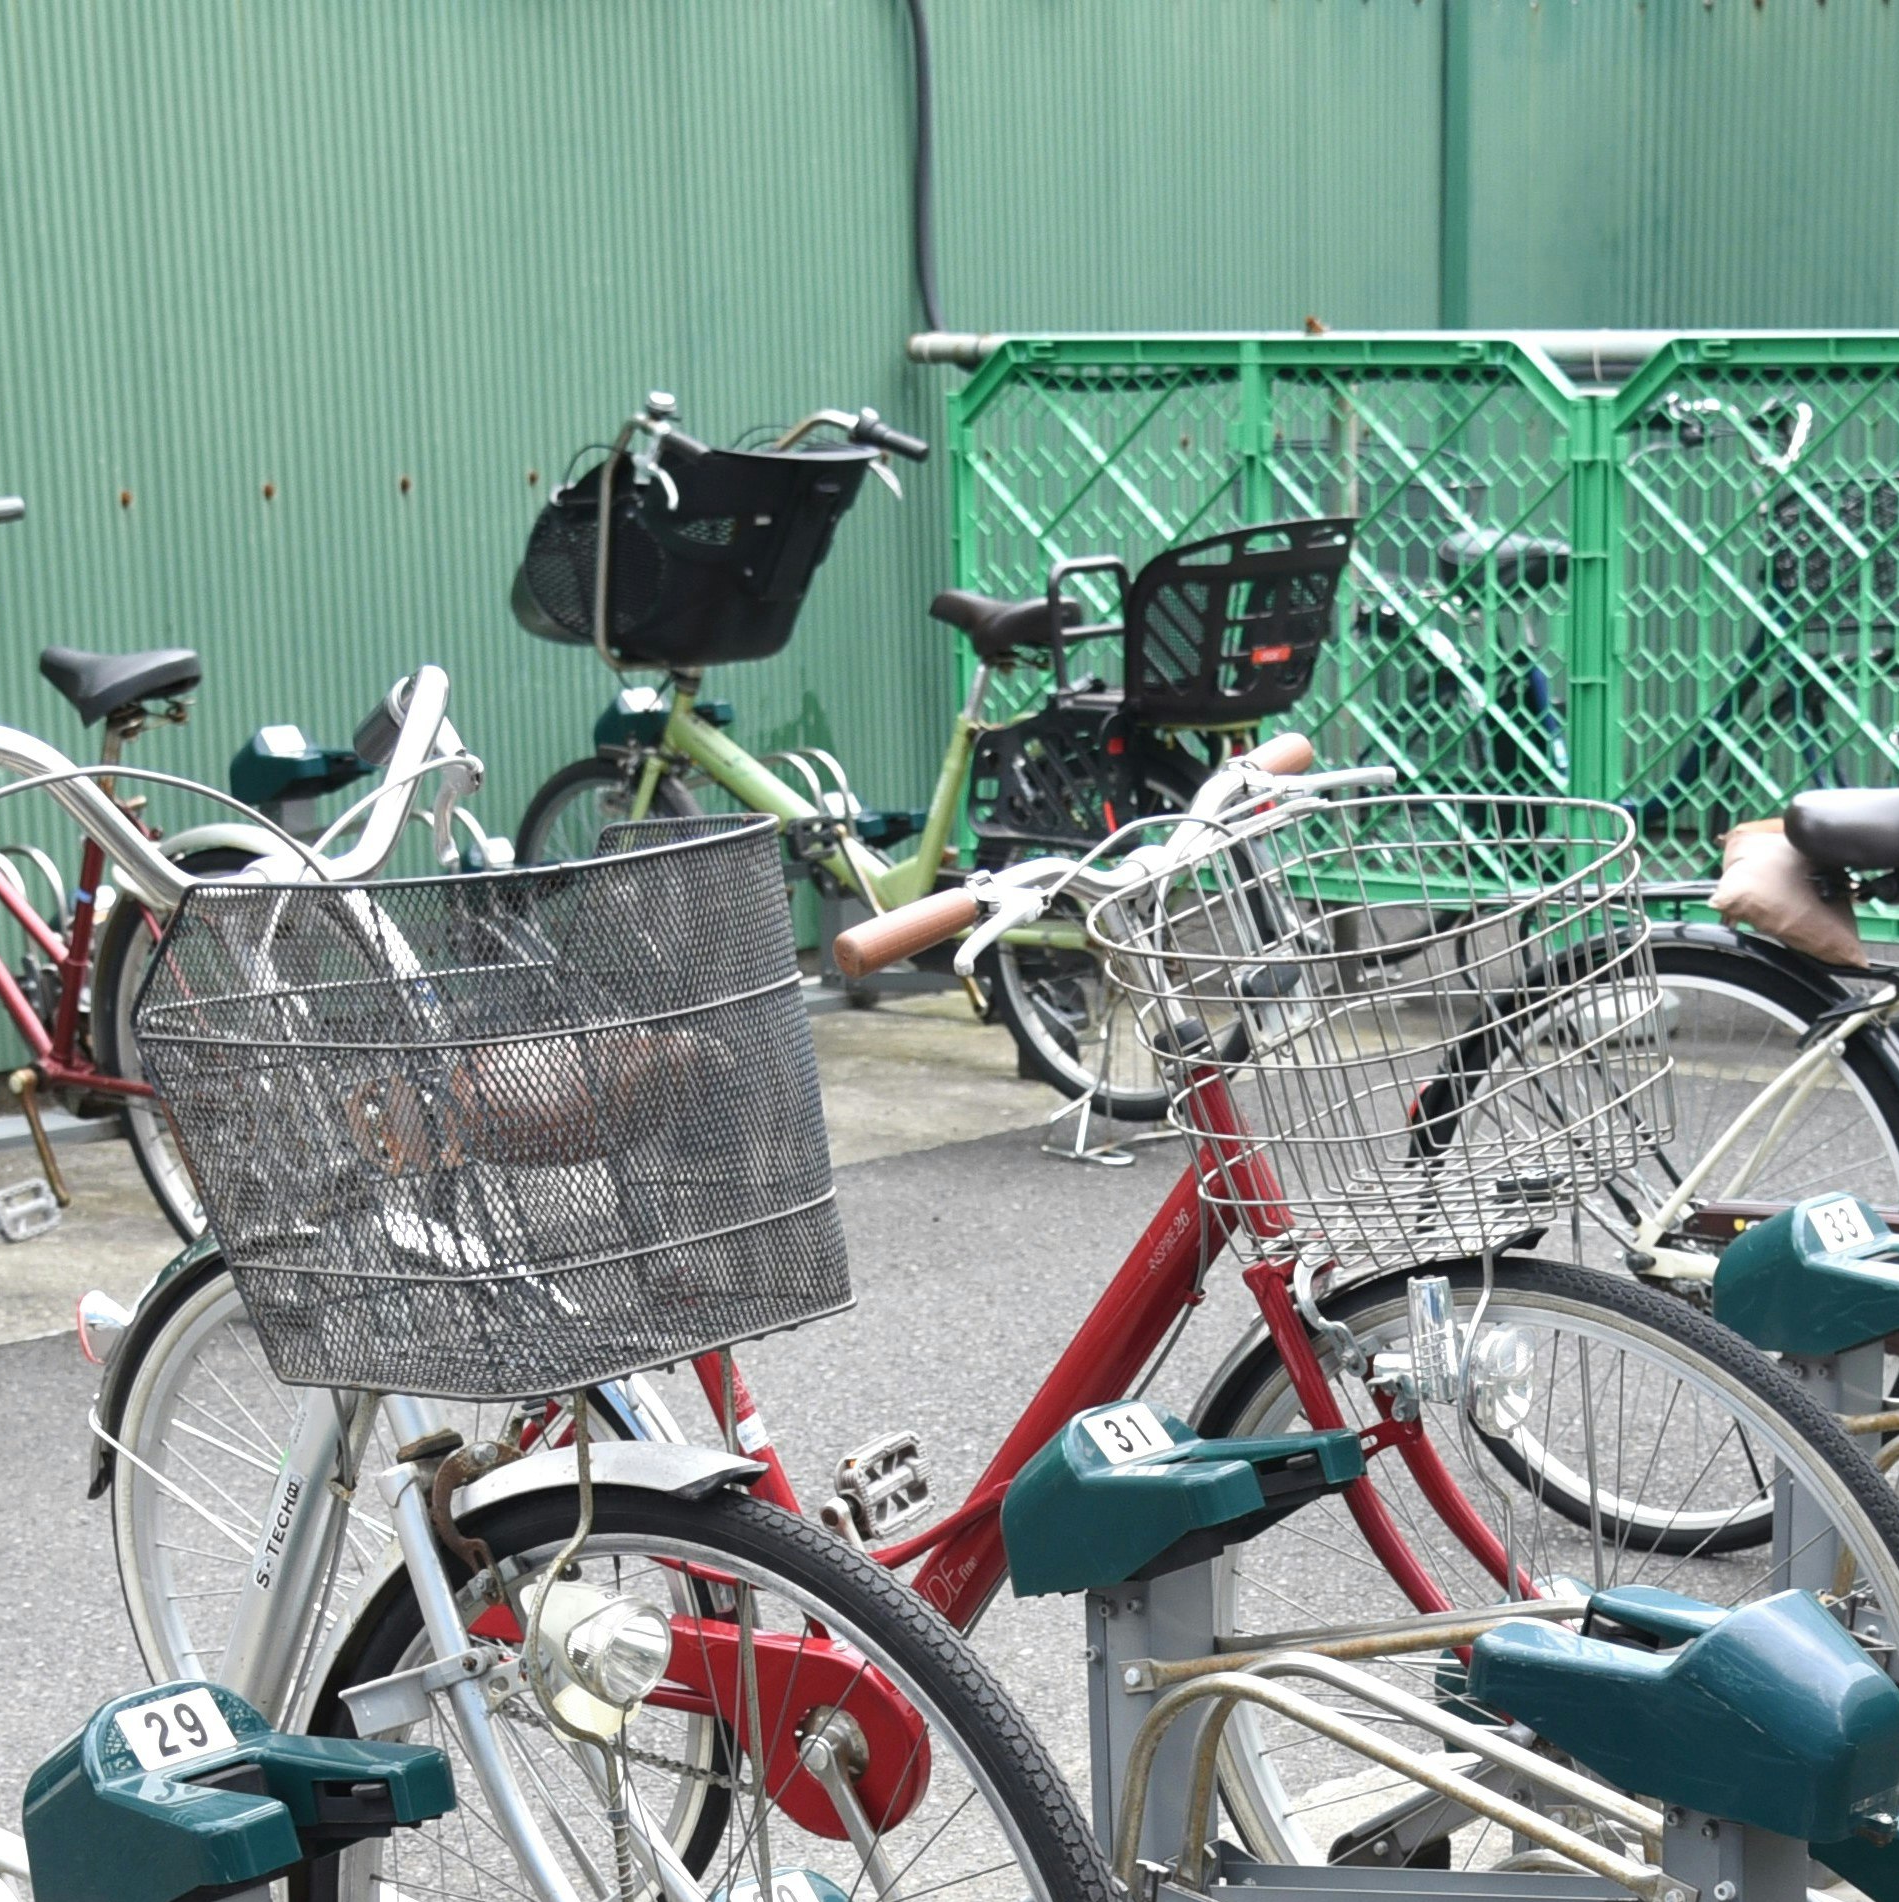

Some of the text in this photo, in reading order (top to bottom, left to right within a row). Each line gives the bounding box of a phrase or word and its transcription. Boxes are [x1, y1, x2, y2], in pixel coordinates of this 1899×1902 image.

[1172, 1207, 1191, 1237] 26
[1823, 1207, 1859, 1243] 33
[1103, 1415, 1152, 1453] 31
[143, 1702, 208, 1758] 29
